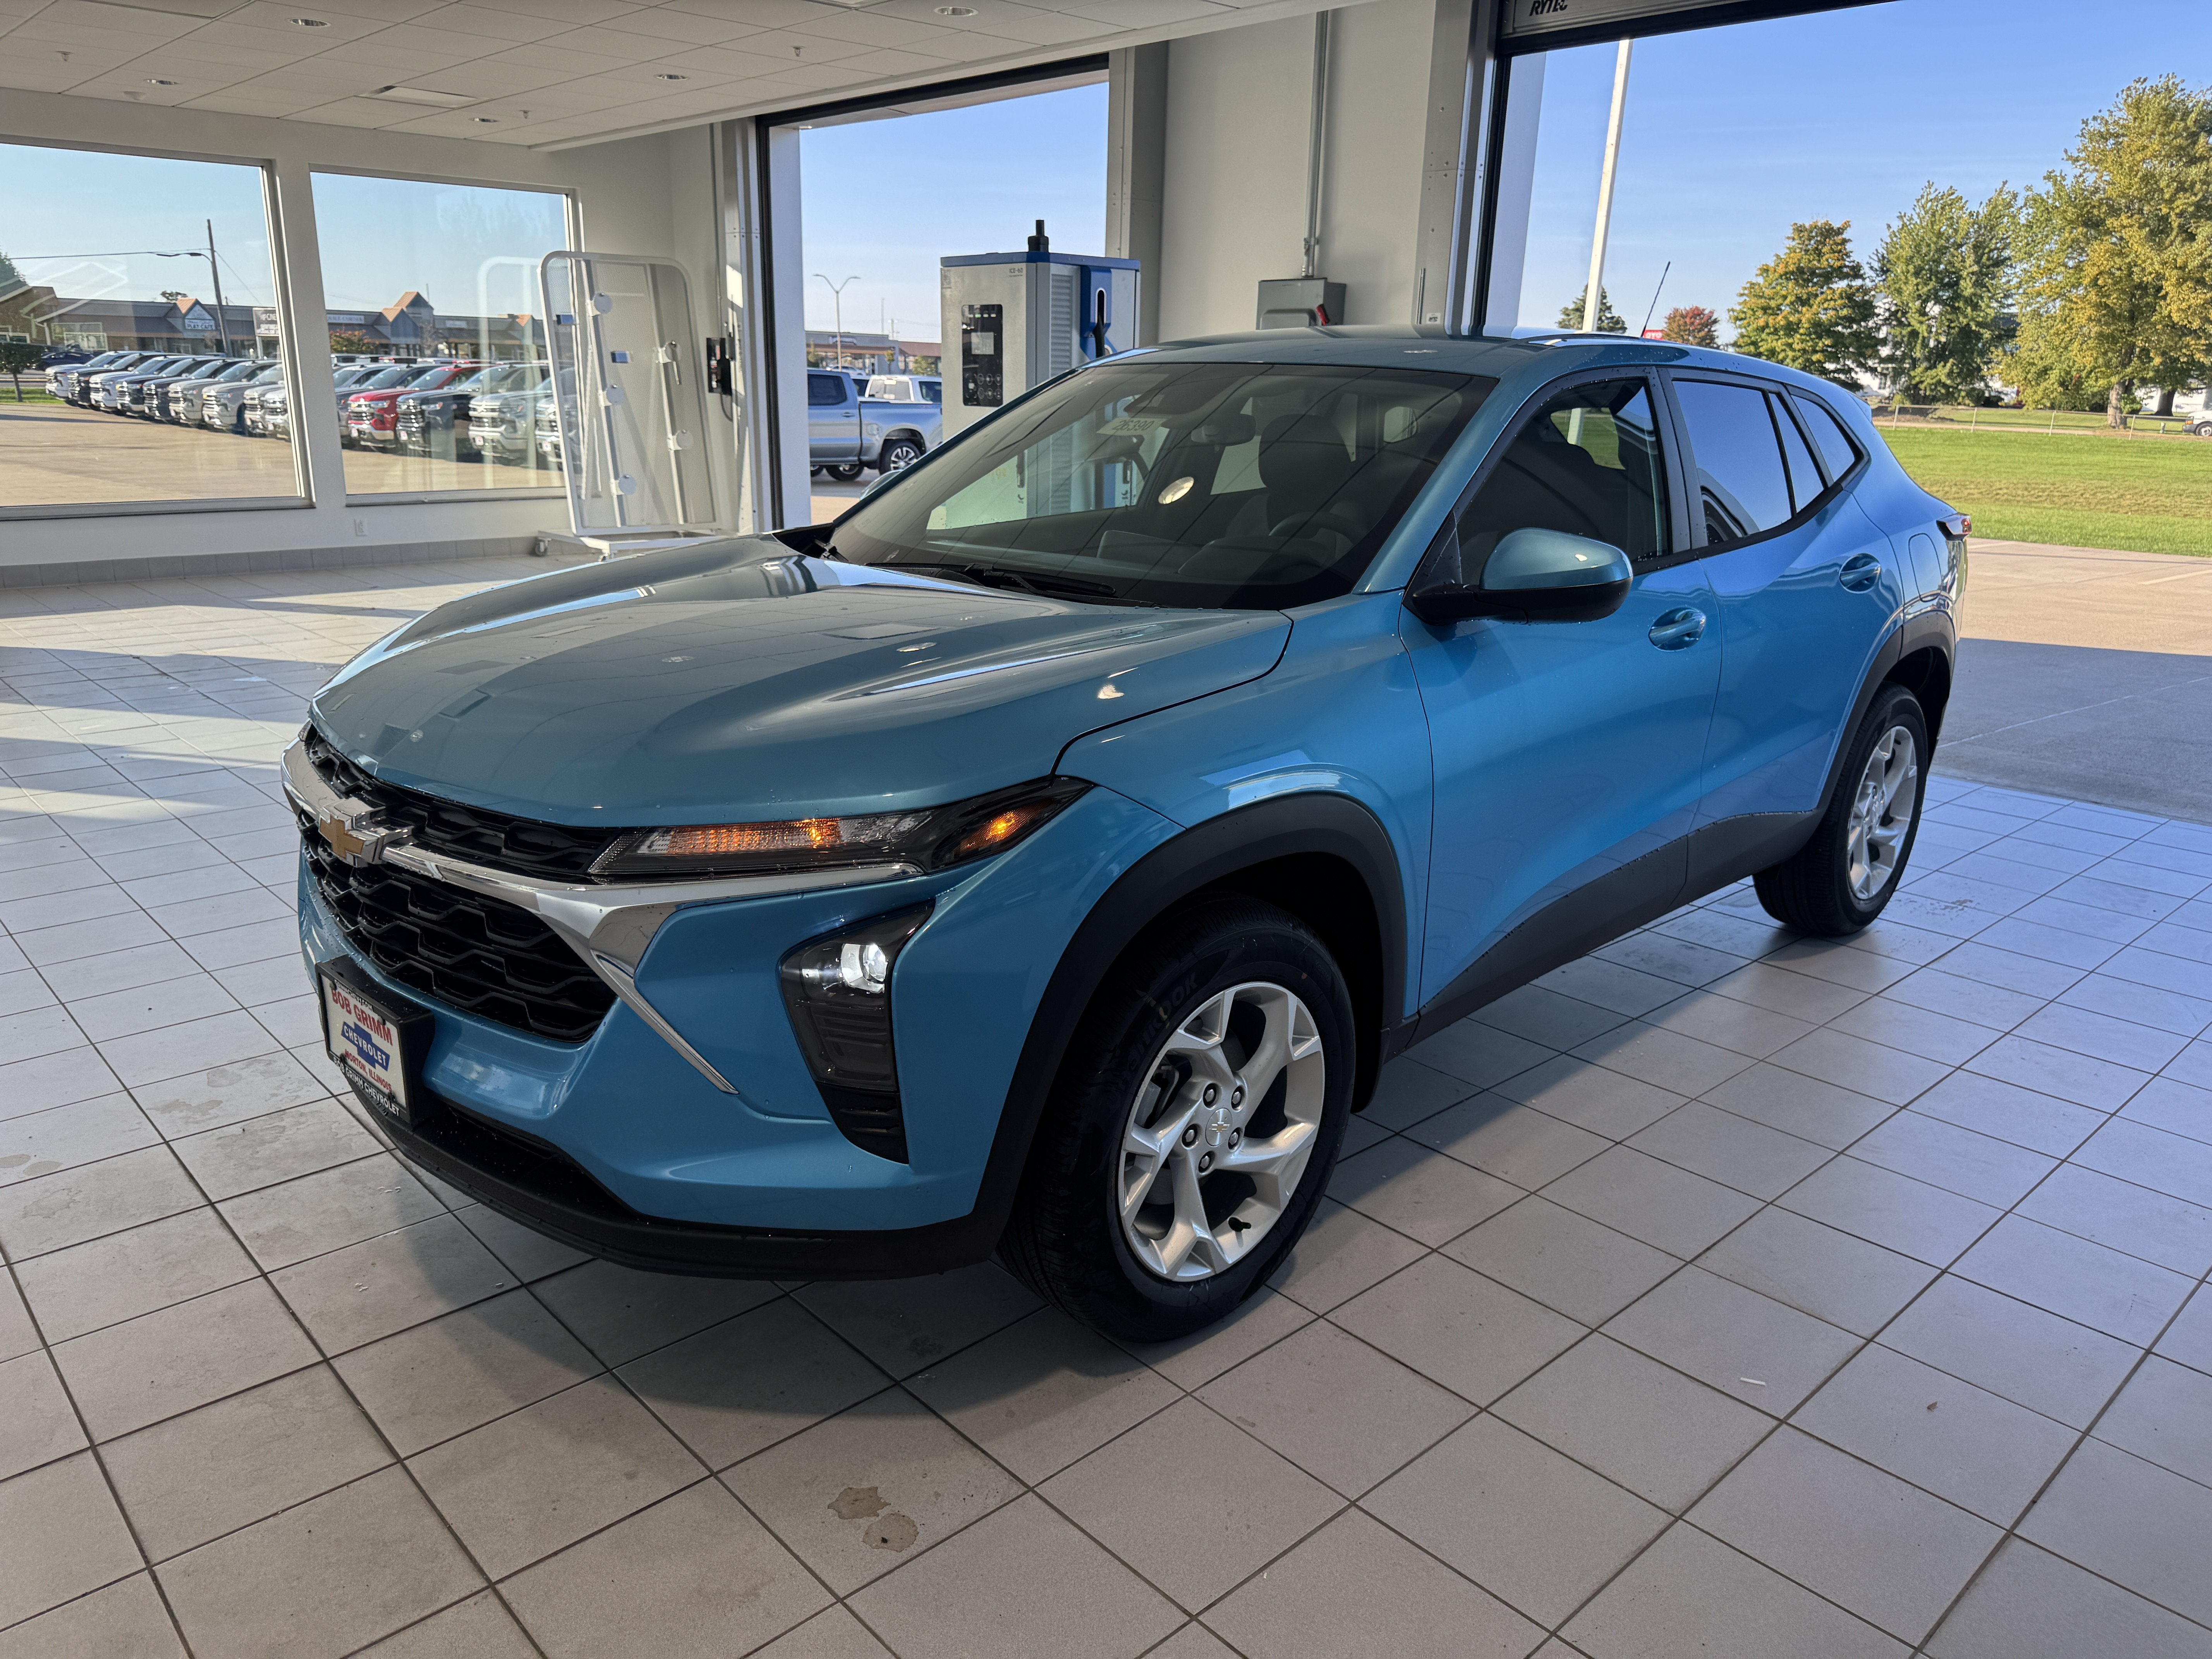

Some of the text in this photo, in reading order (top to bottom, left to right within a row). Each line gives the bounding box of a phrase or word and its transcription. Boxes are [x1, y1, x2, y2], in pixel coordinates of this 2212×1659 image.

[1112, 419, 1155, 431] 26390
[331, 989, 352, 1015] BOB
[353, 1004, 393, 1046] GRIMM
[344, 1025, 386, 1066] CHEVROLET
[345, 1068, 364, 1089] GRIMM
[364, 1083, 400, 1116] CHEVROLET
[368, 1068, 392, 1092] ILLINOIS
